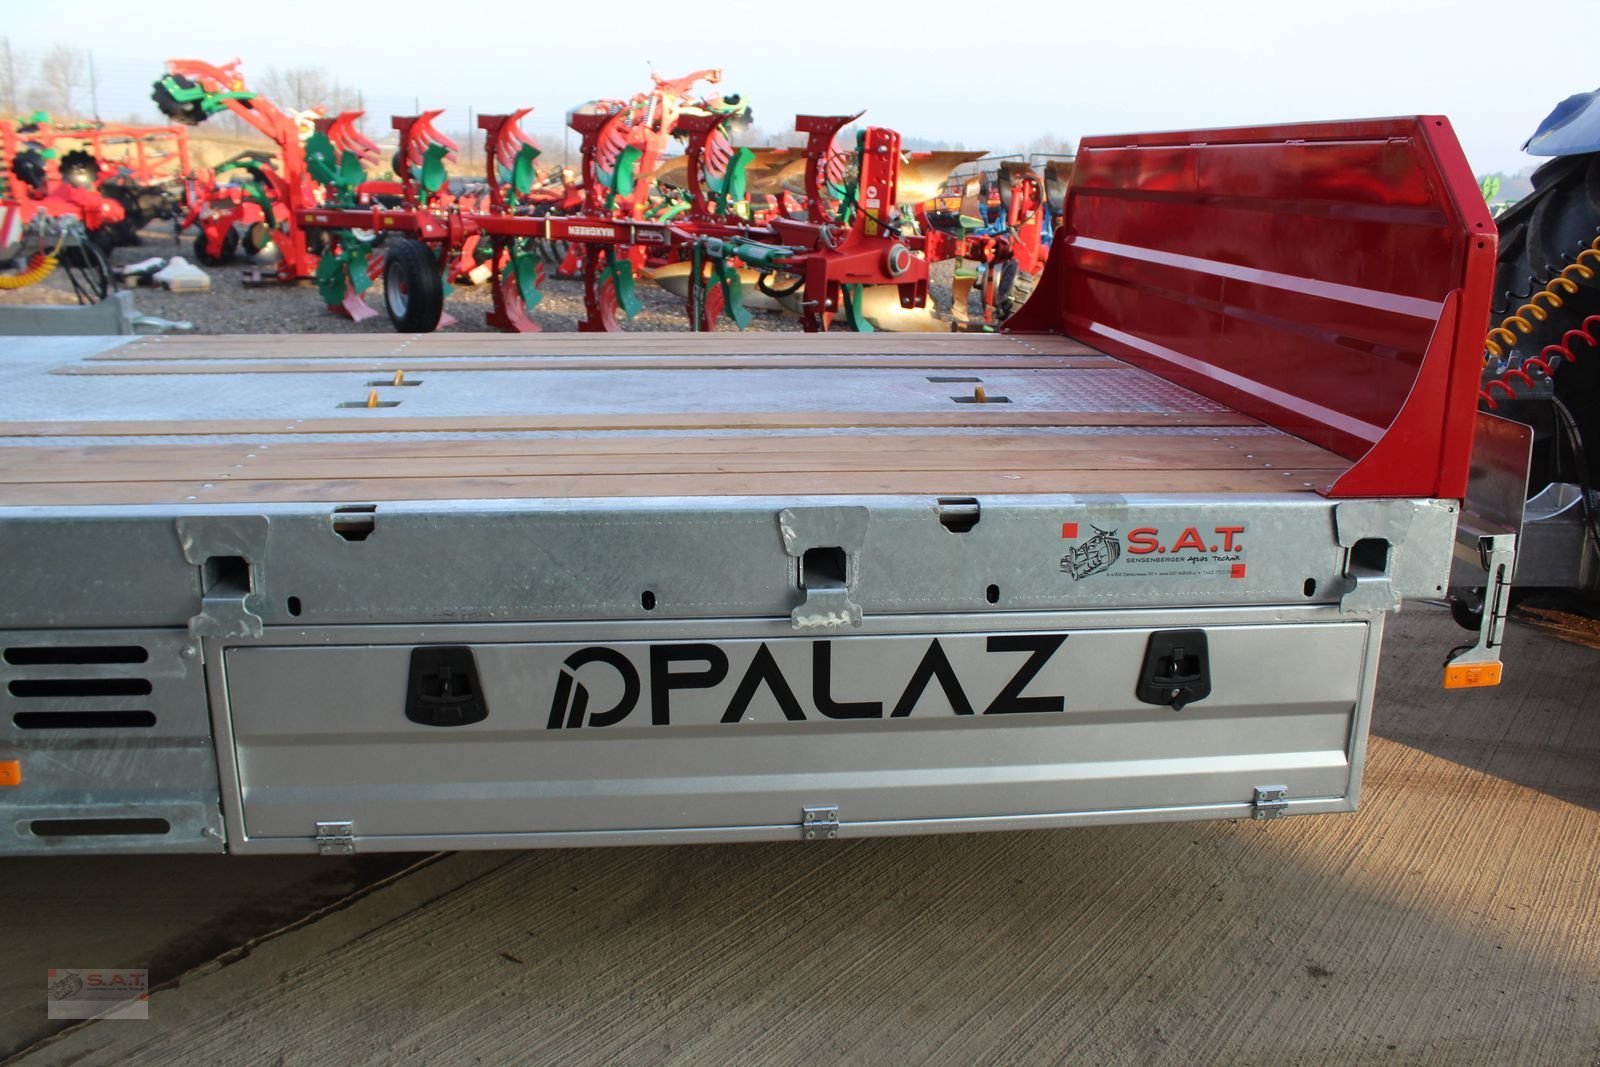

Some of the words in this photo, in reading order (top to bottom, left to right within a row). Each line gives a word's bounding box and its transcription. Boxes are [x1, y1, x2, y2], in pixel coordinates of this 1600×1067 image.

[1127, 526, 1245, 555] S.A.T.
[1126, 556, 1185, 564] SENSENBERGER
[547, 634, 1069, 730] OPALAZ
